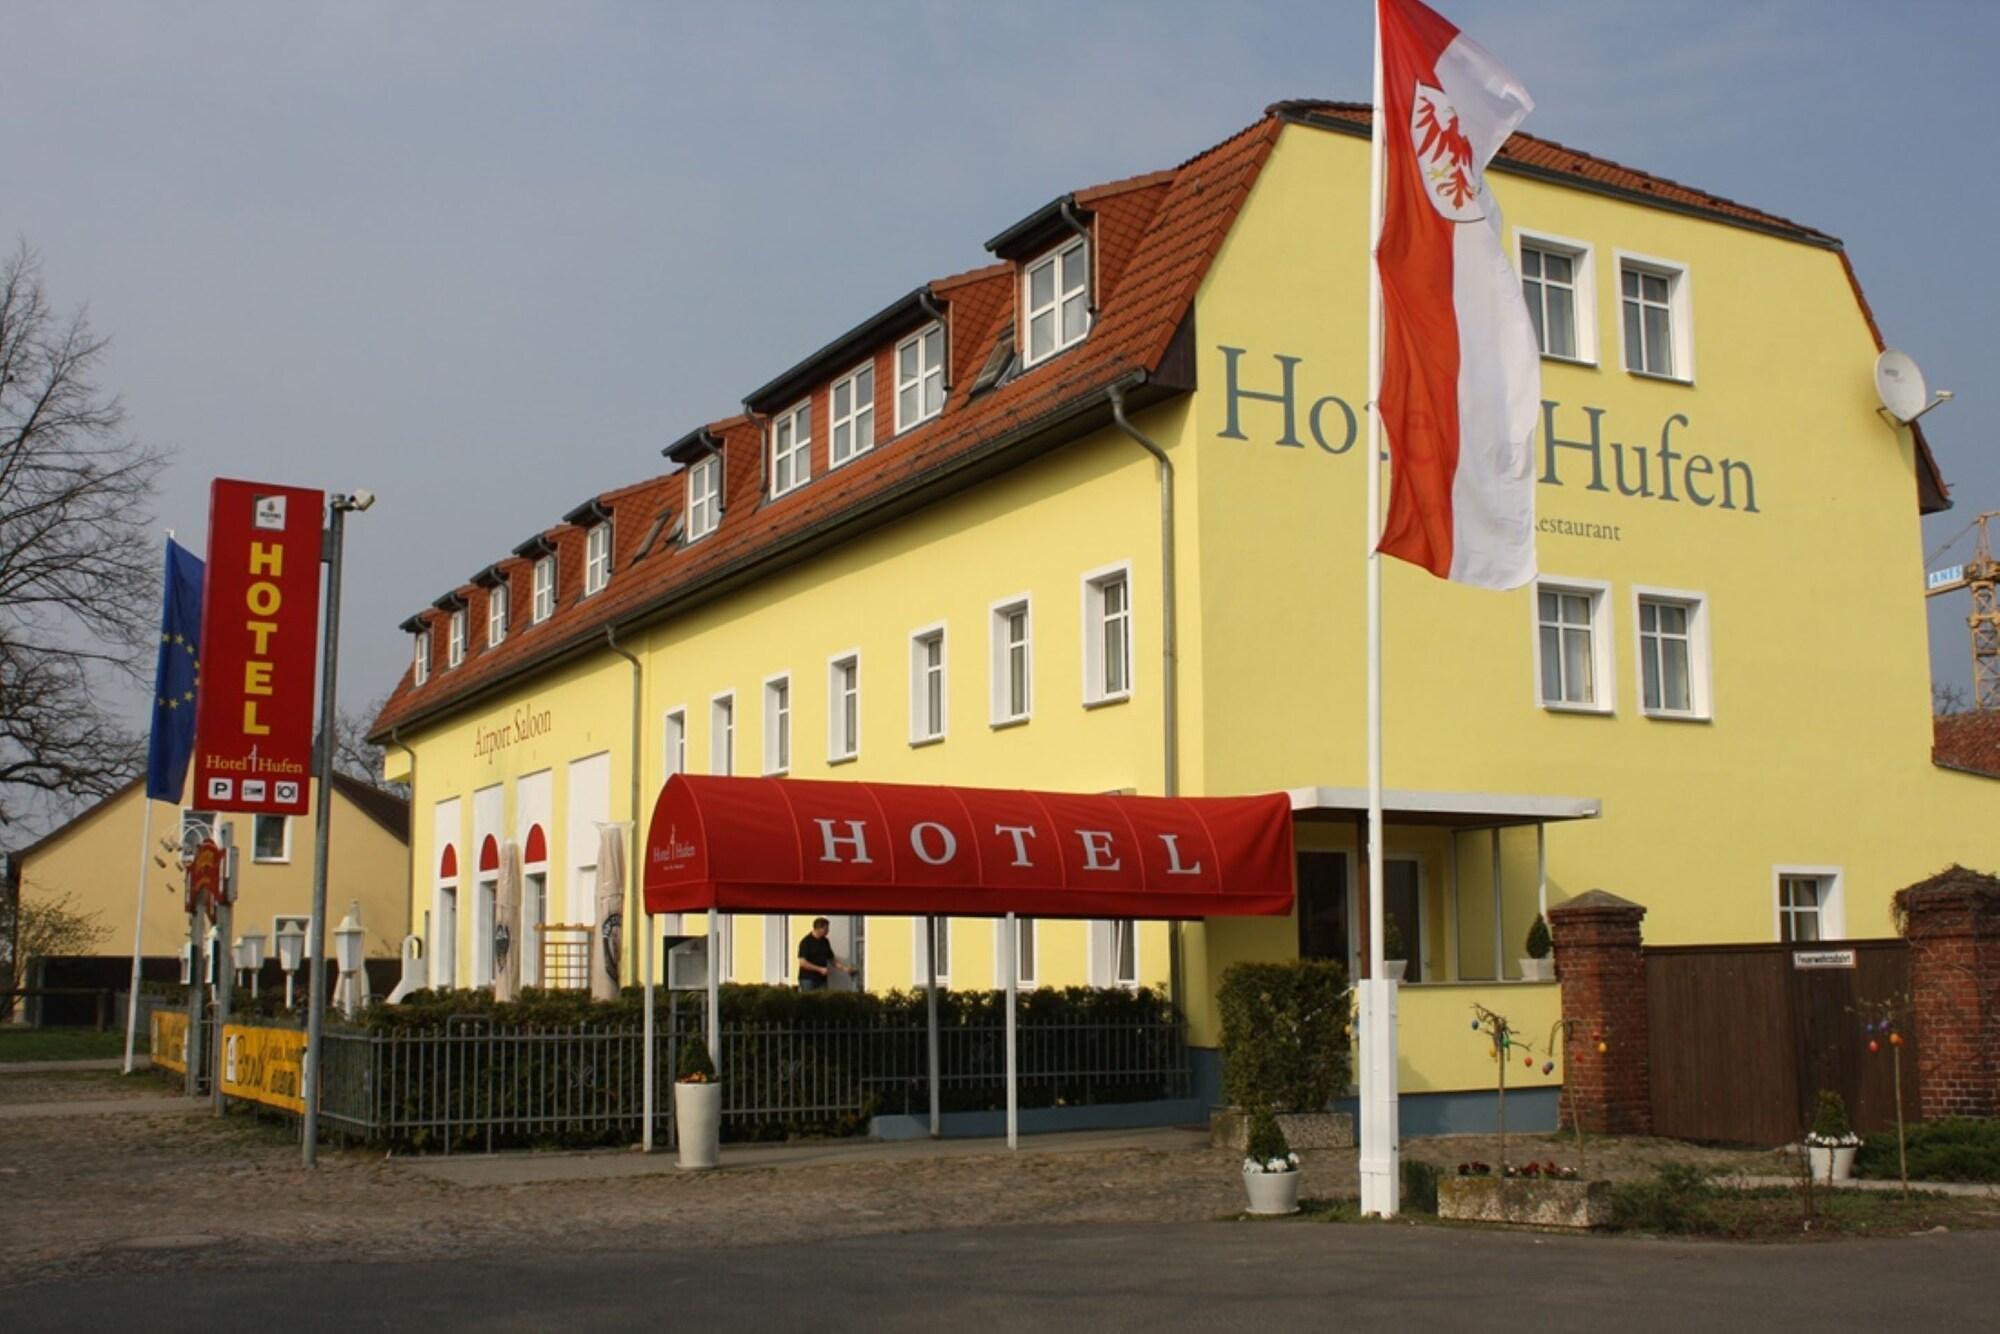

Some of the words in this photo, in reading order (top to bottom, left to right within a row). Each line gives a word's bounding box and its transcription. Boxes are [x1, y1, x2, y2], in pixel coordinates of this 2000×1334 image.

[1537, 399, 1761, 513] Hufen
[244, 542, 283, 736] HOTEL
[206, 754, 248, 770] Hotel
[258, 757, 303, 774] Hufen
[474, 724, 511, 765] Airport
[513, 703, 552, 744] Saloon
[214, 782, 228, 796] P
[813, 817, 1201, 876] HOTEL
